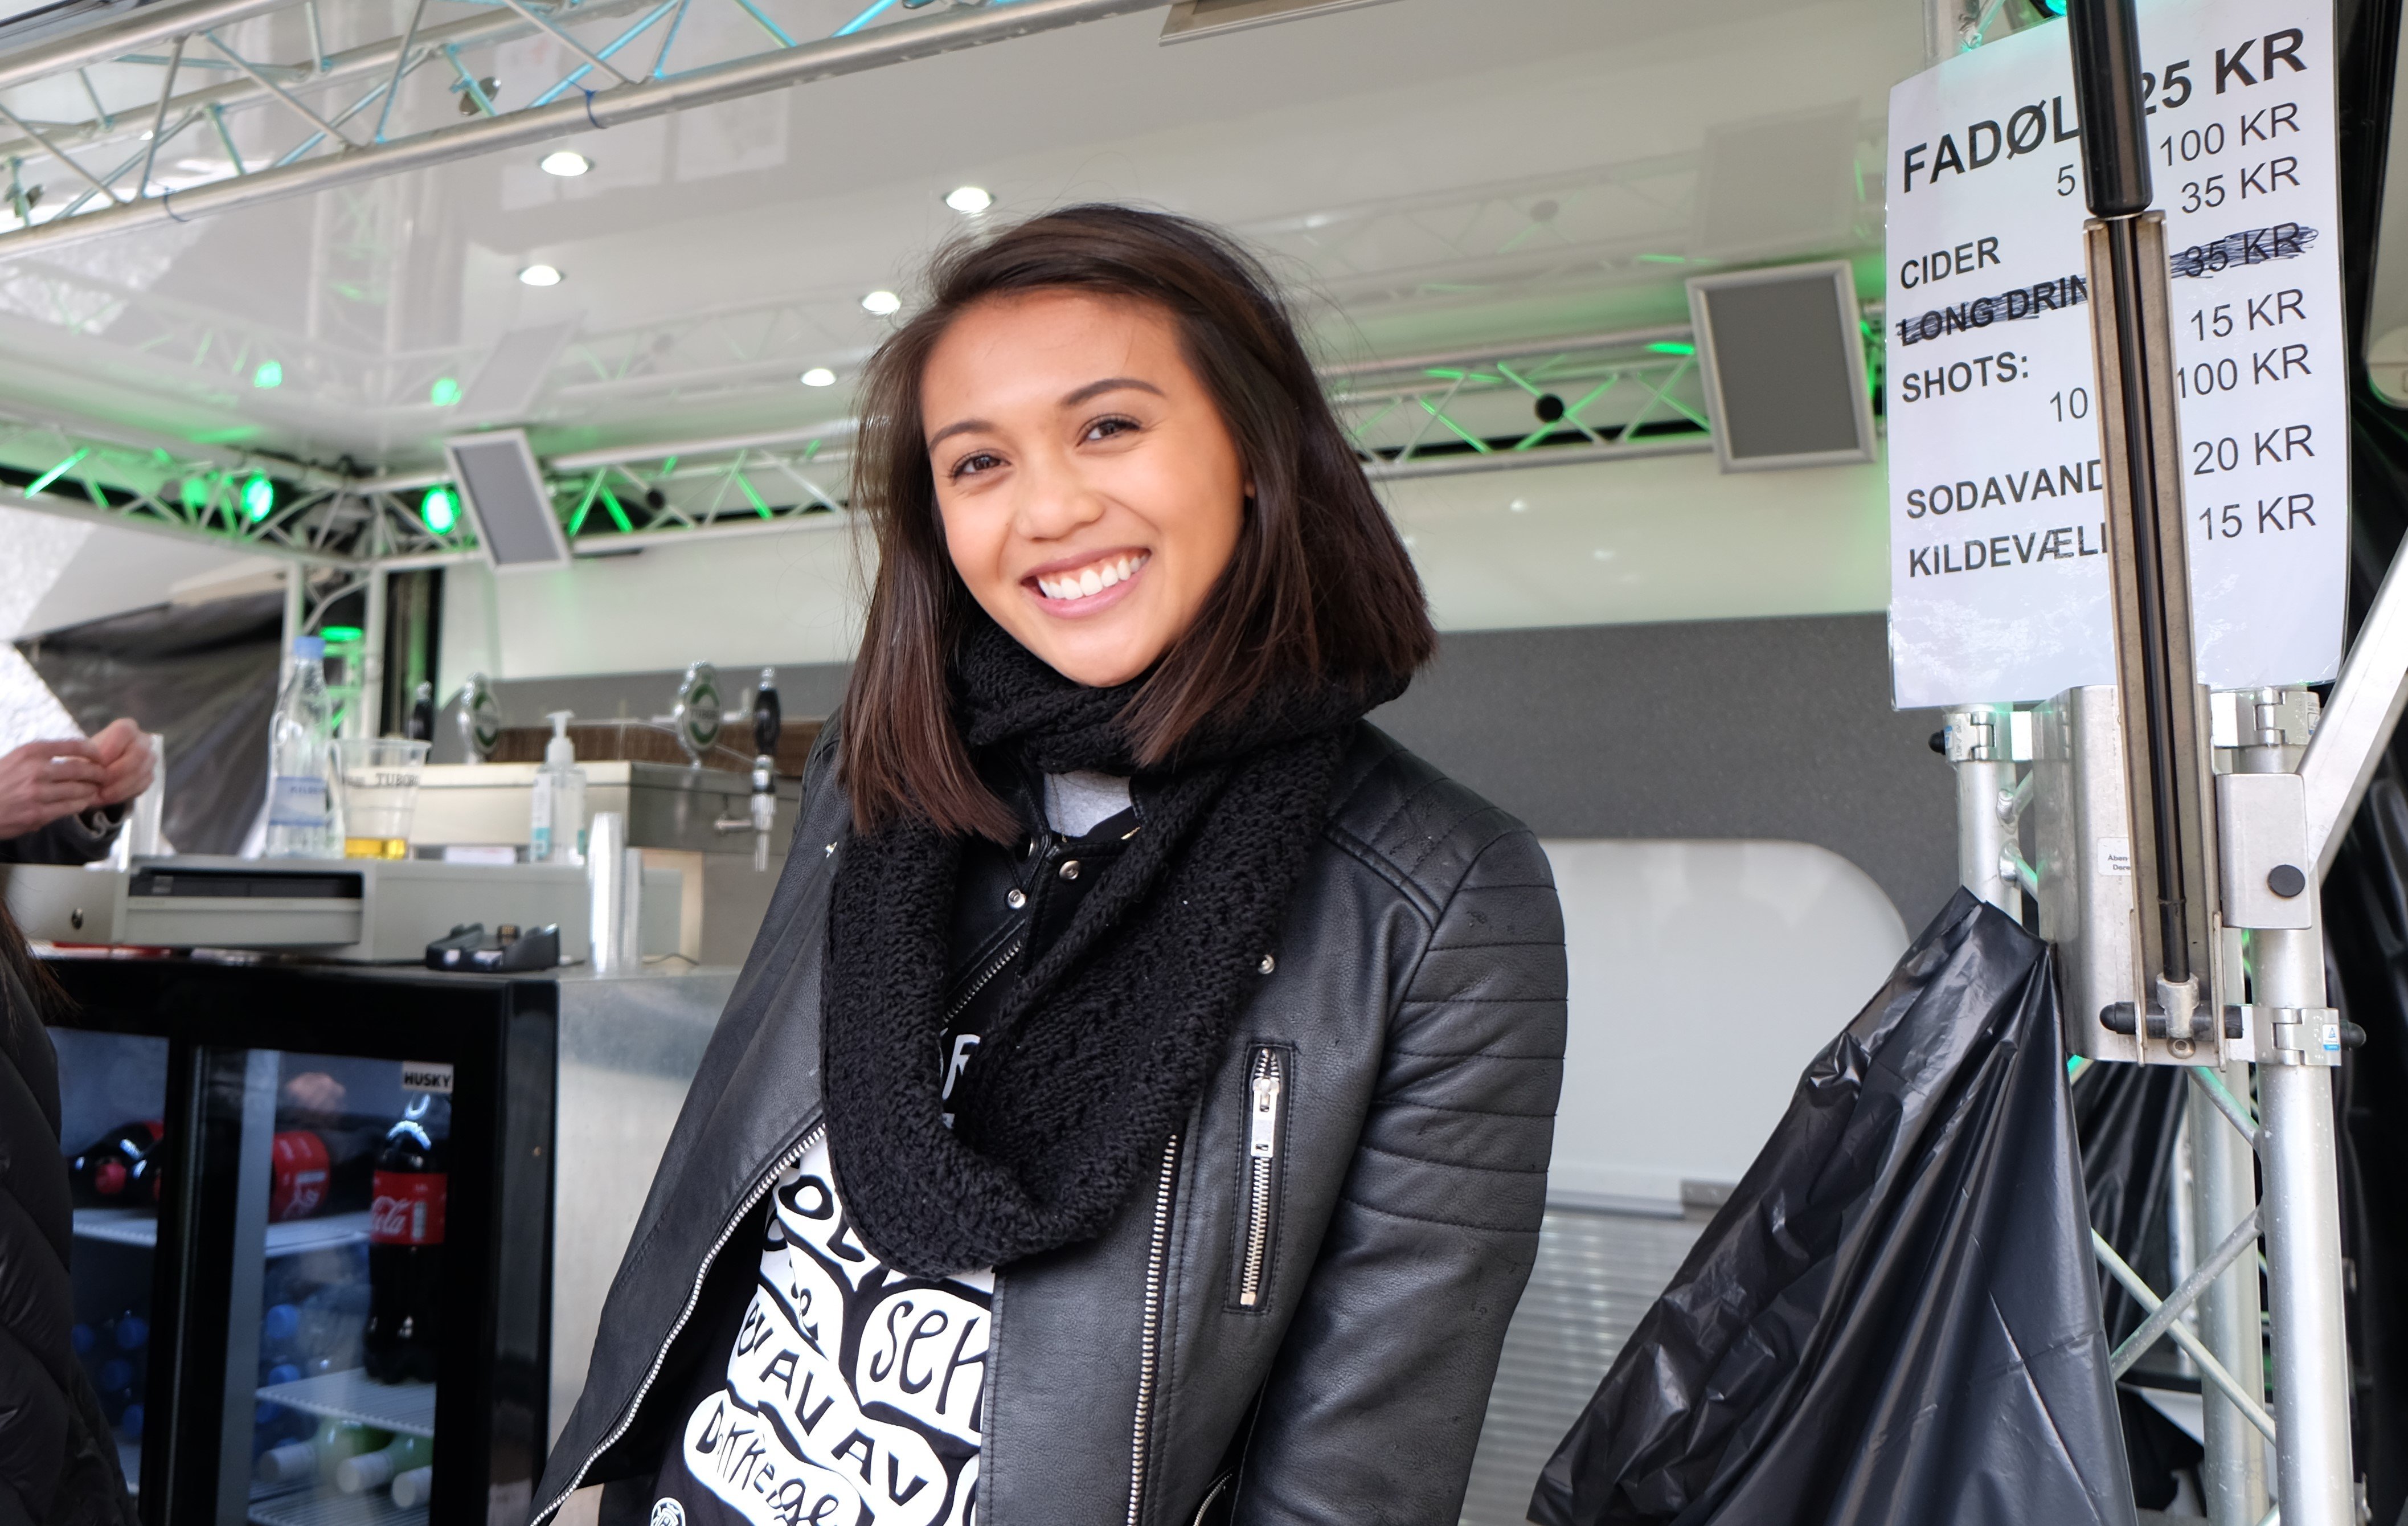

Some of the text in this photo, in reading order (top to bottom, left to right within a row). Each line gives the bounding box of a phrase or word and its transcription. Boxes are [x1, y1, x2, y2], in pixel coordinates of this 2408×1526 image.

[1903, 95, 2081, 194] FADØL
[2215, 28, 2308, 95] KR
[2160, 122, 2225, 167] 100
[2241, 102, 2301, 147] KR
[1900, 156, 2301, 289] CIDER 35 KR
[1901, 297, 1995, 347] LONG
[2183, 244, 2230, 278] 35
[2243, 222, 2304, 269] KR
[1902, 289, 2307, 403] SHOTS: 15 KR
[2050, 343, 2312, 423] 10 100 KR
[2193, 437, 2238, 475] 20
[2254, 424, 2316, 467] KR
[2200, 504, 2243, 541] 15
[2258, 493, 2316, 534] KR
[404, 1072, 451, 1087] HUSKY
